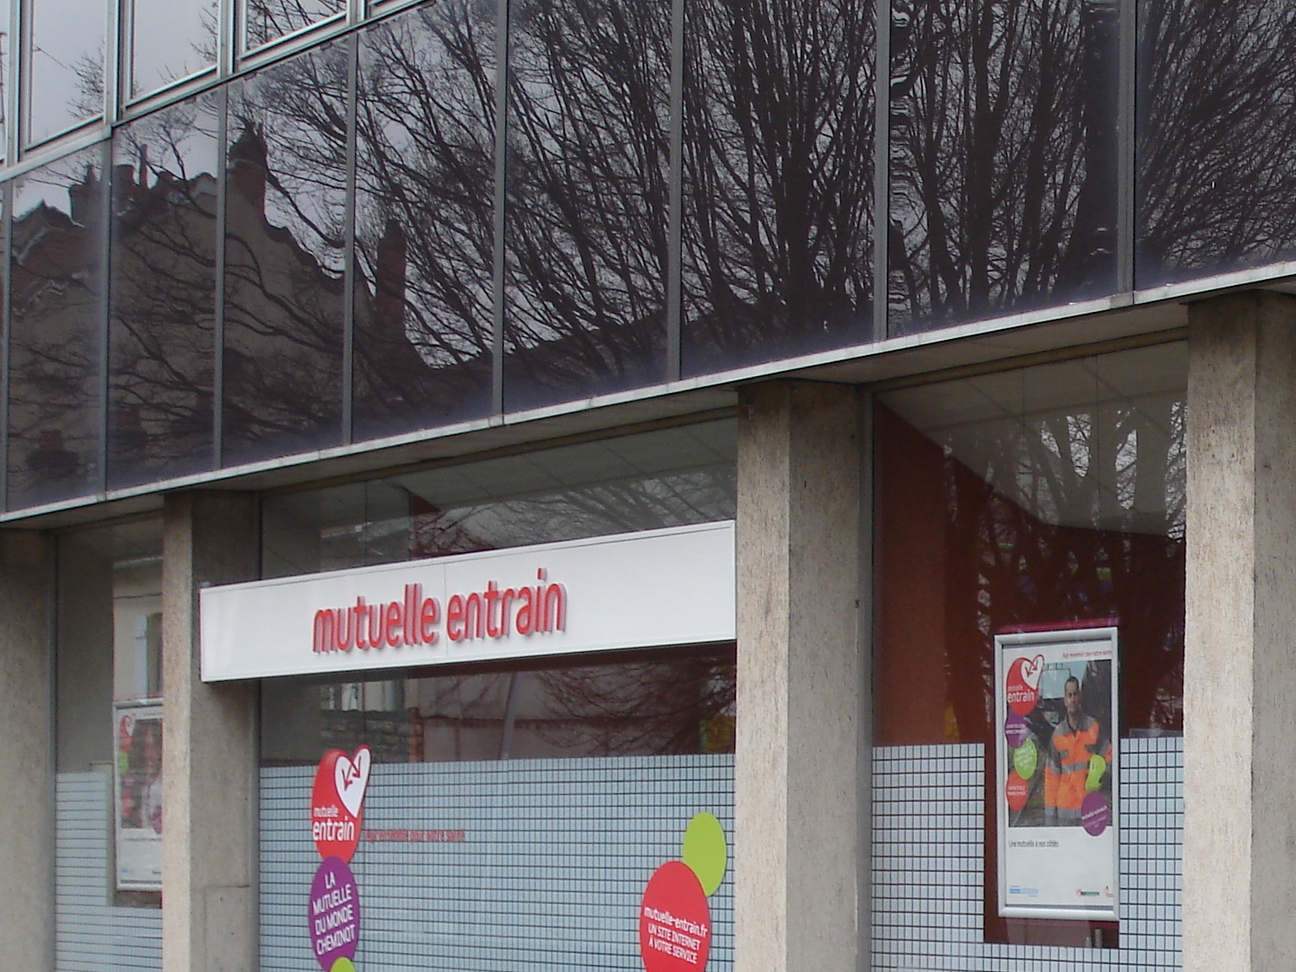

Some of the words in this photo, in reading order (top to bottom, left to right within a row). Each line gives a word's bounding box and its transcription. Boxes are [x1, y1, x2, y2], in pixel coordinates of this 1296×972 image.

[313, 583, 440, 654] mutuelle
[447, 567, 567, 641] entrain
[1007, 689, 1035, 703] entrain
[313, 805, 339, 817] mutuelle
[312, 816, 354, 841] entrain
[325, 871, 336, 889] LA
[312, 883, 352, 916] MUTUELLE
[315, 916, 326, 936] DU
[326, 904, 354, 930] MONDE
[644, 906, 708, 938] mutuelle-entrain.fr
[316, 924, 355, 955] CHEMINOT
[648, 922, 657, 935] UN
[657, 926, 672, 940] SITE
[672, 930, 701, 951] INTERNET
[654, 937, 672, 955] VOTRE
[672, 944, 698, 965] SERVICE
